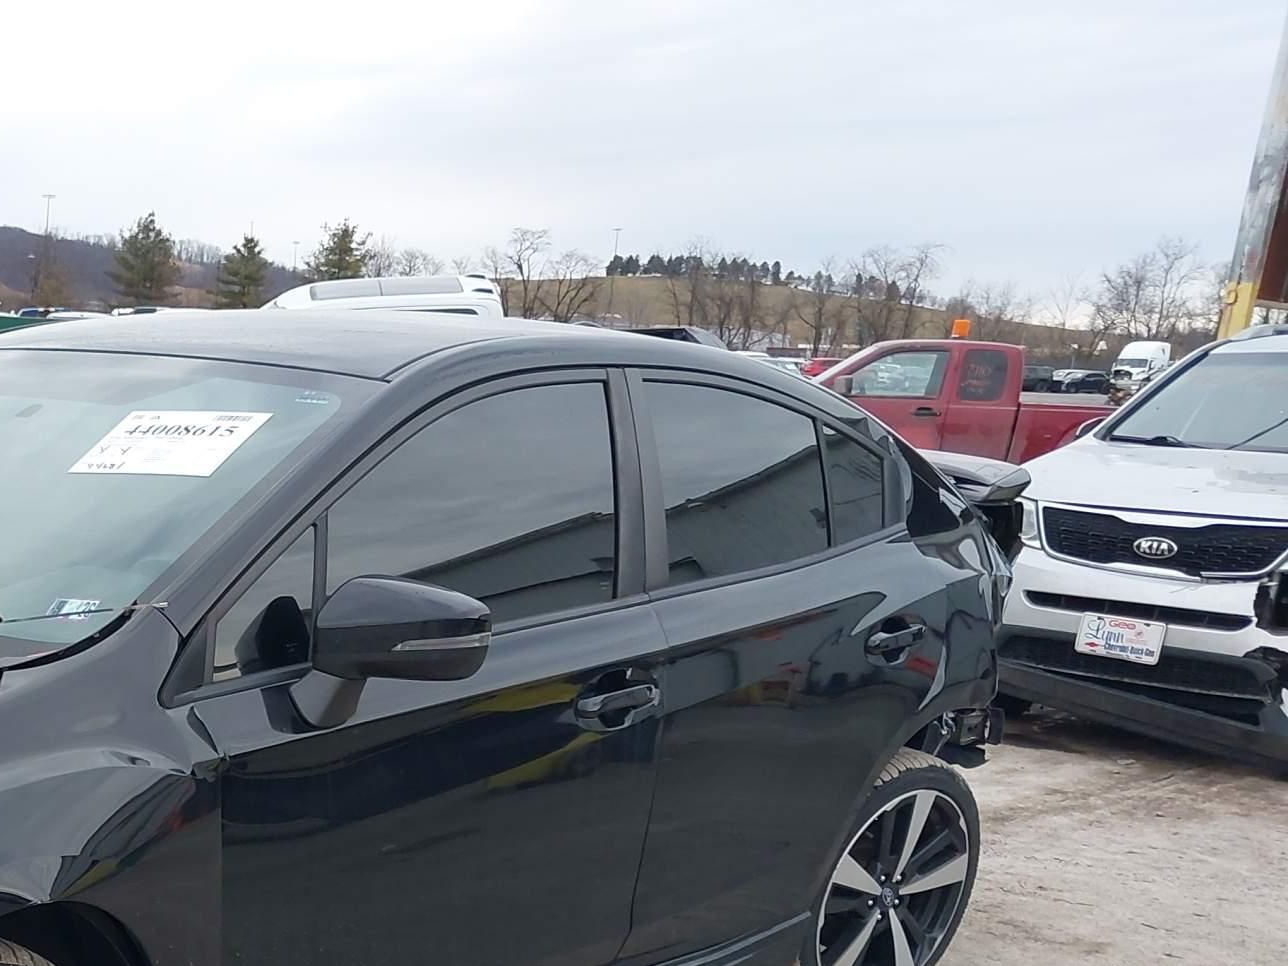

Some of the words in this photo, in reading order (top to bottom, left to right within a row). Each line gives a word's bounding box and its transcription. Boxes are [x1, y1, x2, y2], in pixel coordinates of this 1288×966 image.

[125, 424, 239, 437] 44008615
[1140, 541, 1168, 554] KIA
[1085, 619, 1124, 643] Lynn
